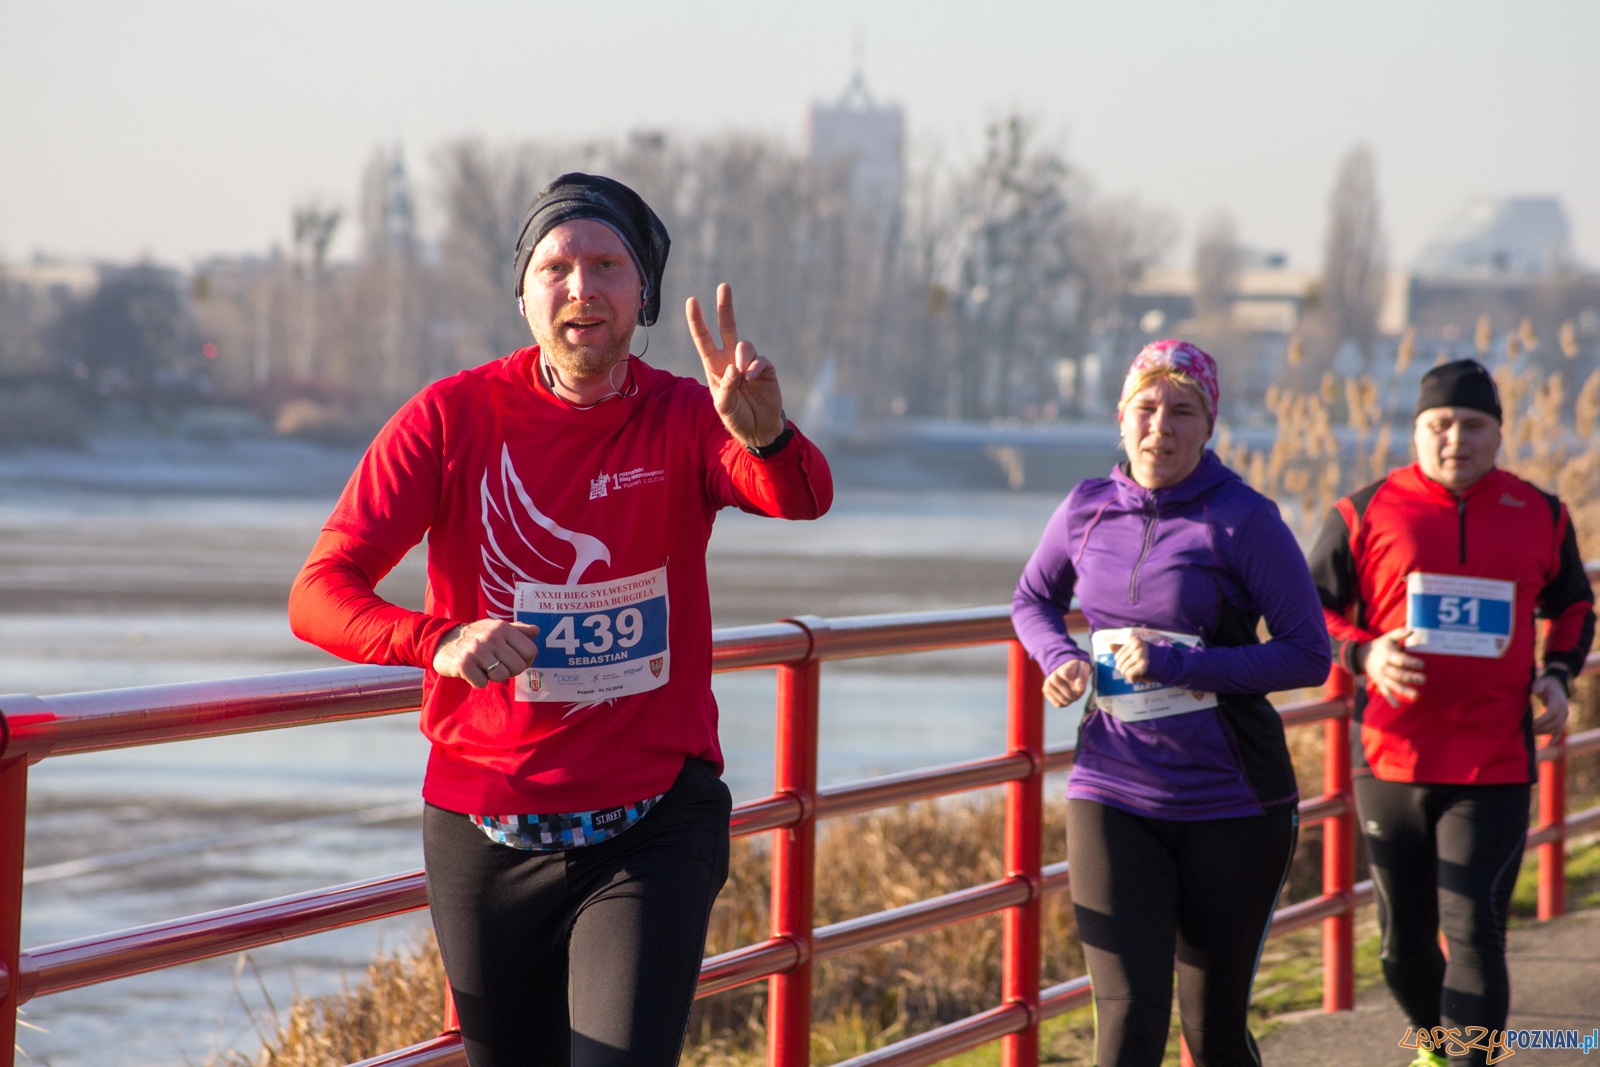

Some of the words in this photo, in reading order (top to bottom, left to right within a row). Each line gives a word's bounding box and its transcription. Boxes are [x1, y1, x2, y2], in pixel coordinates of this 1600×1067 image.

[534, 590, 562, 600] XXXII
[564, 590, 588, 600] BIEG
[590, 576, 657, 598] SYLWESTROWY
[539, 601, 554, 610] IM.
[556, 600, 610, 611] RYSZARDA
[611, 588, 654, 606] BURGIELA
[1437, 596, 1480, 625] 51
[545, 607, 644, 656] 439
[568, 651, 628, 666] SEBASTIAN
